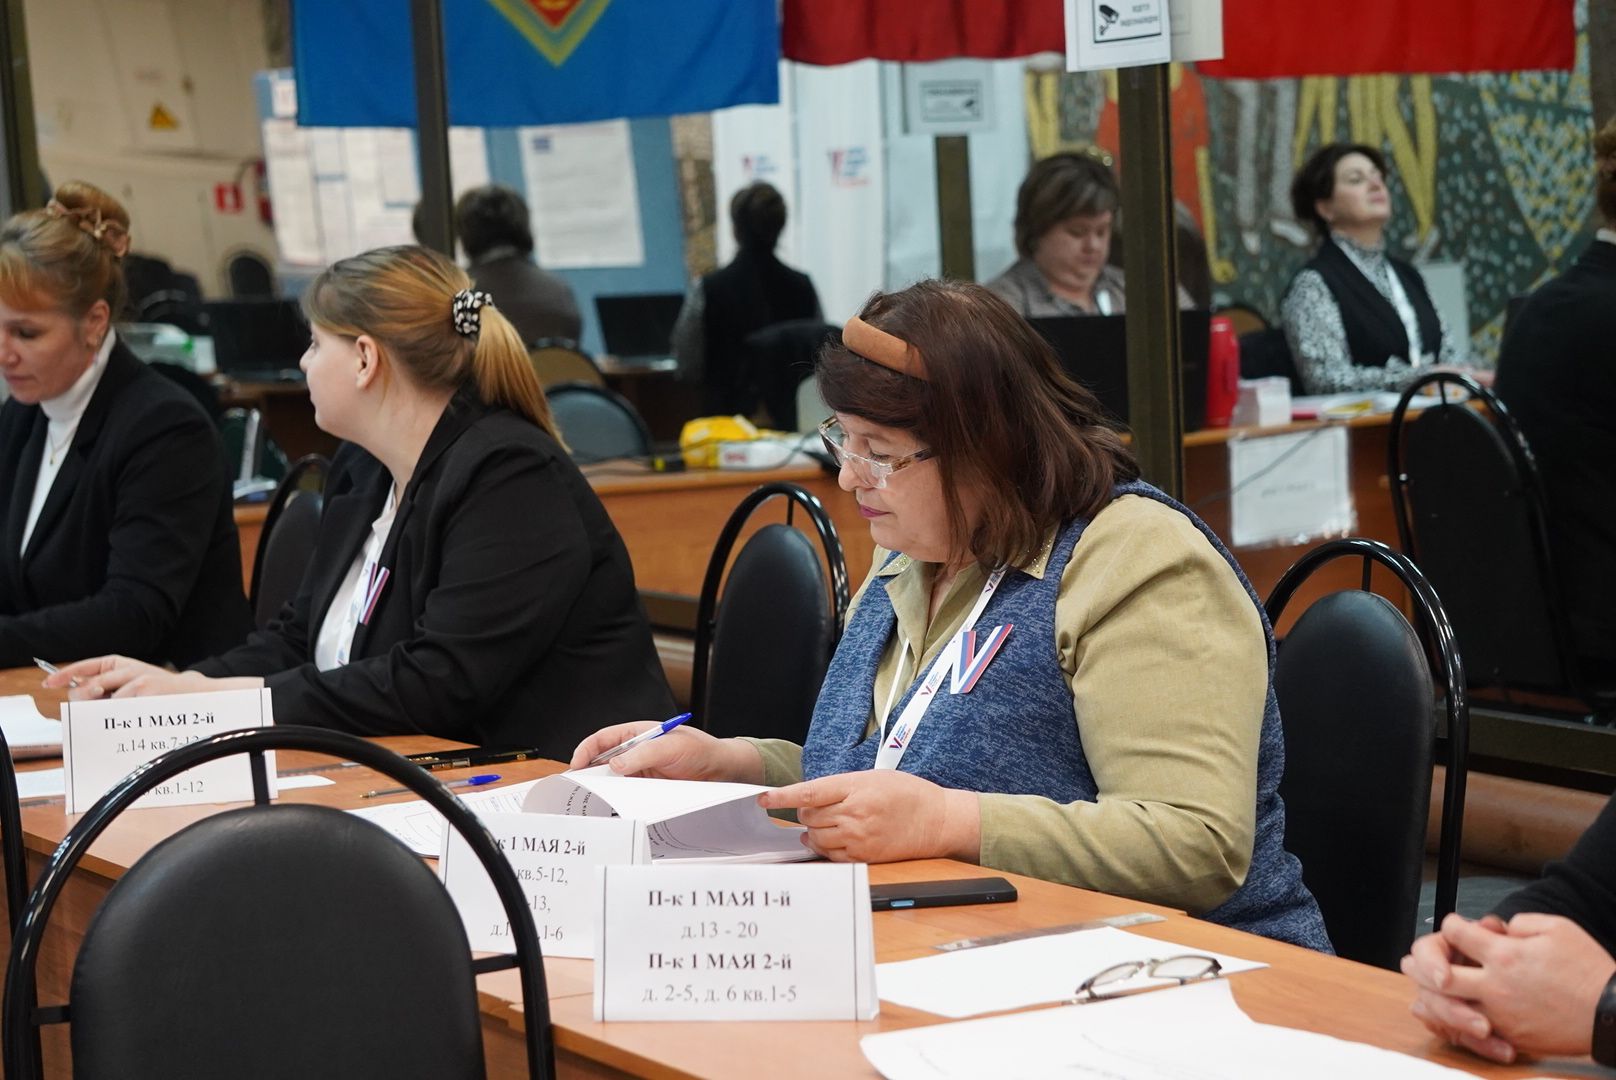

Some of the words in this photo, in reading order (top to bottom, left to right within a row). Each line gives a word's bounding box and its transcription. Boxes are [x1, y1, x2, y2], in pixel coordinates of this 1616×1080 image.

[104, 717, 132, 730] П-к
[138, 716, 143, 728] 1
[149, 714, 187, 727] МАЯ
[192, 712, 215, 725] 2-й
[116, 737, 146, 754] д.14
[511, 836, 517, 850] 1
[522, 837, 560, 853] МАЯ
[564, 840, 585, 855] 2-й
[648, 890, 684, 907] П-к
[691, 890, 698, 907] 1
[705, 890, 755, 907] МАЯ
[763, 889, 791, 907] 1-й
[680, 921, 719, 940] д.13
[737, 921, 759, 939] 20
[648, 953, 684, 970] П-к
[691, 953, 698, 970] 1
[705, 953, 756, 970] МАЯ
[762, 952, 792, 970] 2-й
[664, 984, 699, 1004] 2-5,
[726, 983, 737, 1001] 6
[742, 983, 797, 1002] кв.1-5
